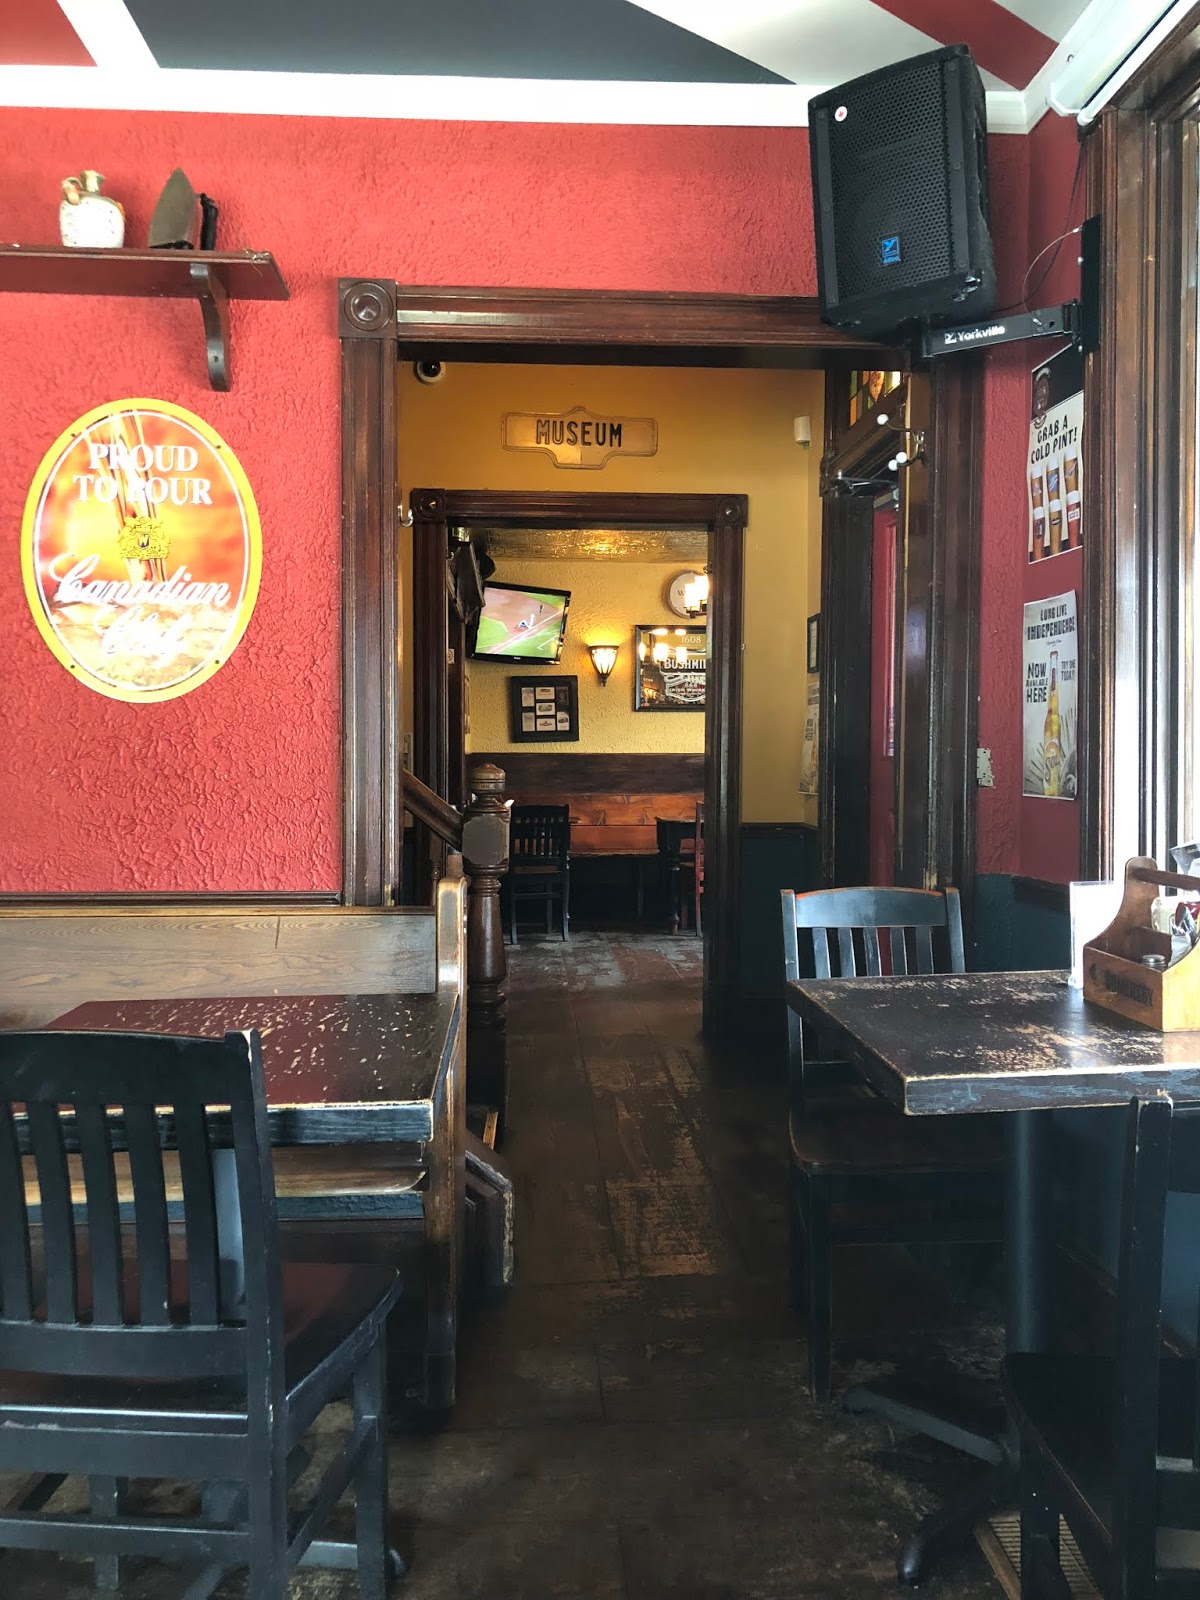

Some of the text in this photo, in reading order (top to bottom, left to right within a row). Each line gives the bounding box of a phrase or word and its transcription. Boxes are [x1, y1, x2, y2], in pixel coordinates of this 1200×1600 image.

[957, 325, 1006, 341] Yorkville
[536, 419, 622, 447] MUSEUM
[1037, 414, 1068, 443] GRAB A
[88, 443, 199, 472] PROUD
[1031, 426, 1077, 464] COLD PINT!
[72, 474, 213, 505] TO POUR
[49, 553, 232, 607] Canadian
[1040, 603, 1068, 621] LONG LIVE
[681, 635, 702, 644] 1608
[1027, 616, 1075, 641] INDEPENDENCE
[1027, 662, 1047, 679] NOW
[1026, 686, 1047, 703] HERE
